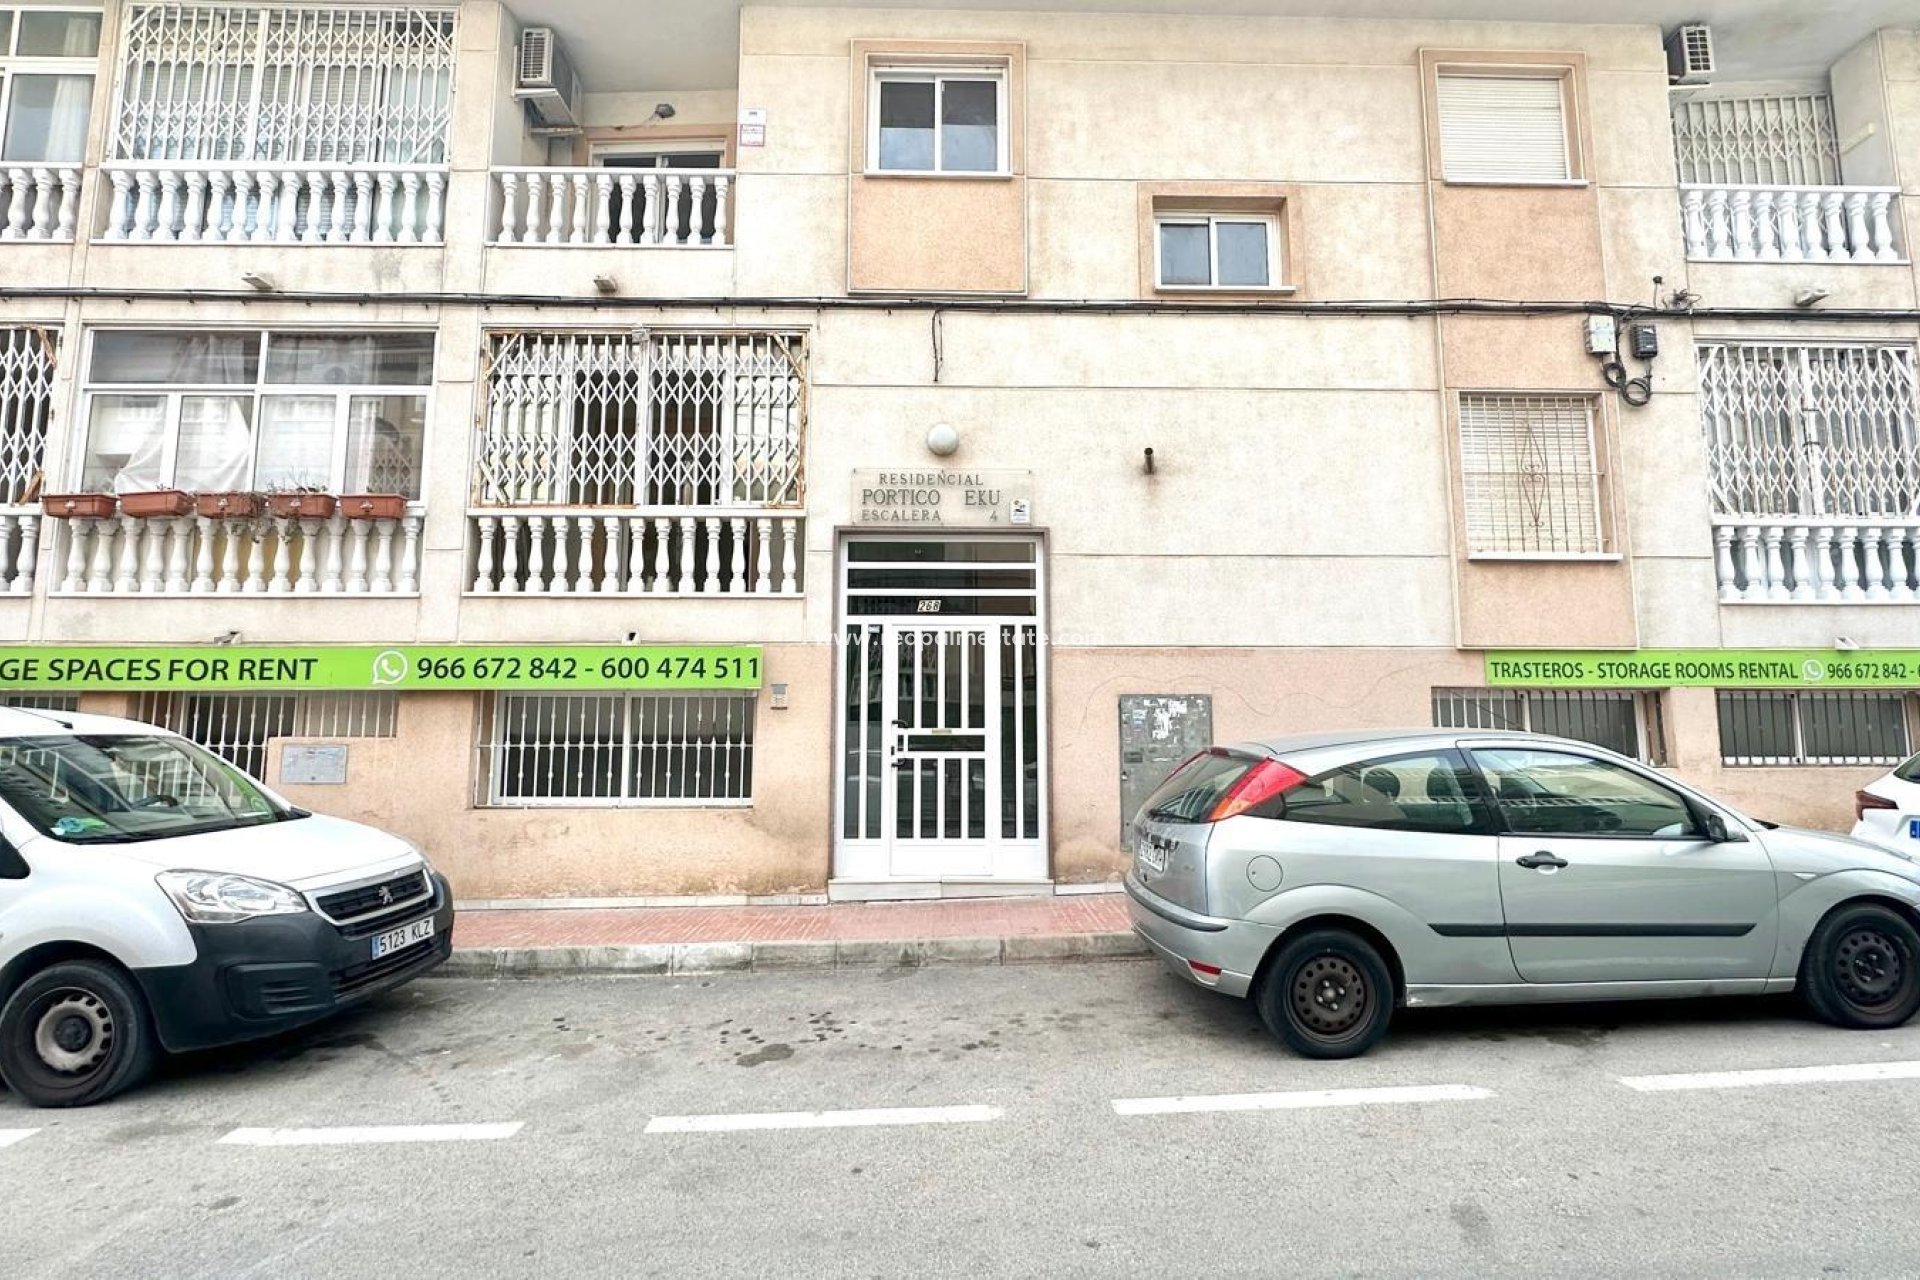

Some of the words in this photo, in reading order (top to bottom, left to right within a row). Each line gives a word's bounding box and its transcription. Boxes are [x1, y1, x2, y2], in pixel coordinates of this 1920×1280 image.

[879, 473, 984, 486] RESIDENCIAL
[862, 489, 941, 505] PORTICO
[964, 490, 1001, 506] EKU
[862, 510, 942, 521] ESCALERA
[990, 510, 998, 522] 4
[0, 658, 40, 681] GE
[47, 658, 161, 681] SPACES
[168, 659, 229, 681] FOR
[238, 658, 319, 681] RENT
[417, 657, 466, 679] 966
[473, 657, 521, 679] 672
[529, 657, 577, 679] 842
[601, 657, 650, 679] 600
[656, 657, 707, 679] 474
[714, 657, 758, 679] 511
[1490, 662, 1584, 679] TRASTEROS
[1597, 662, 1671, 679] STORAGE
[1675, 662, 1735, 679] ROOMS
[1739, 662, 1799, 679] RENTAL
[1827, 663, 1853, 679] 966
[1855, 663, 1880, 679] 672
[1882, 663, 1907, 679] 842
[379, 929, 405, 953] 5123
[411, 919, 431, 940] KLZ
